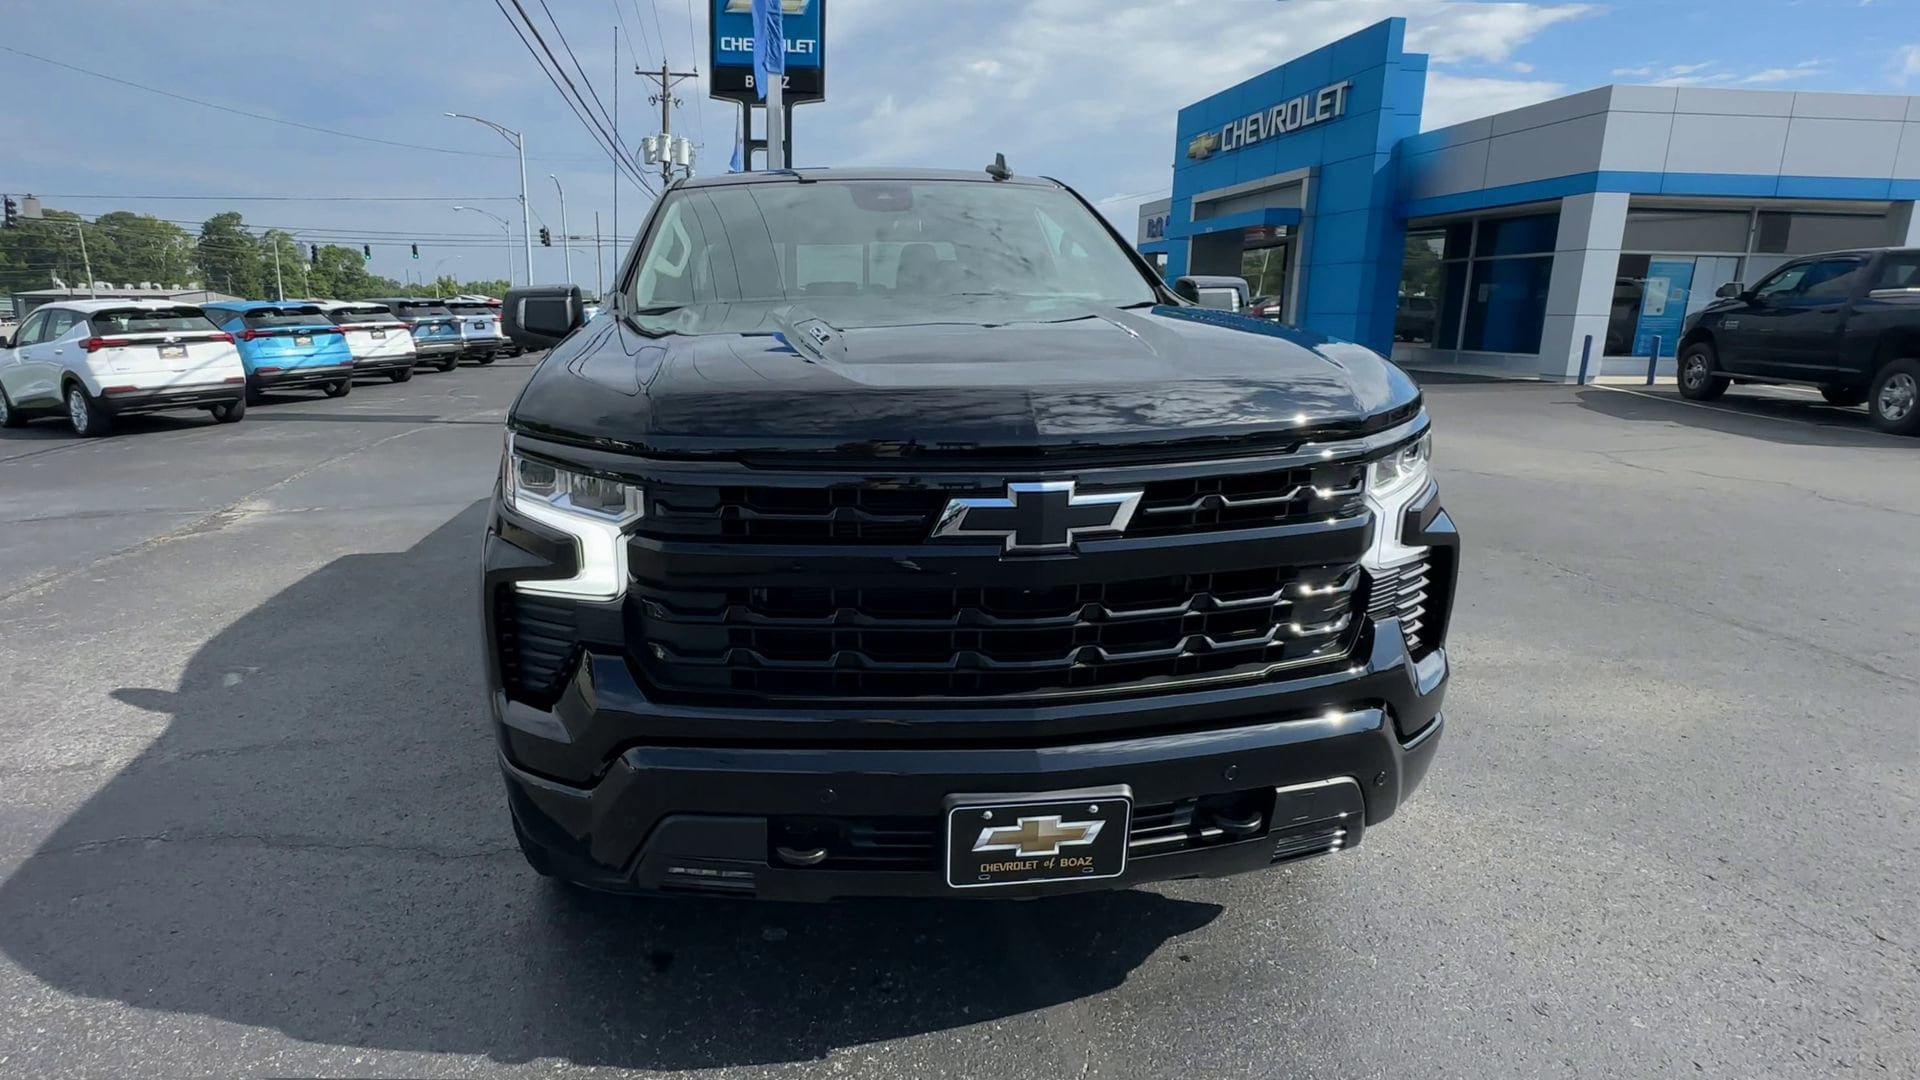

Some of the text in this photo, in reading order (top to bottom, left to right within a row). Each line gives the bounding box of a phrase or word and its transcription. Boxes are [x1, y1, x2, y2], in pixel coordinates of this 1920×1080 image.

[720, 37, 816, 53] CHELET
[745, 75, 790, 88] BZ
[1221, 79, 1349, 152] CHEVROLET
[980, 856, 1093, 872] CHEVROLET of BOAZ
